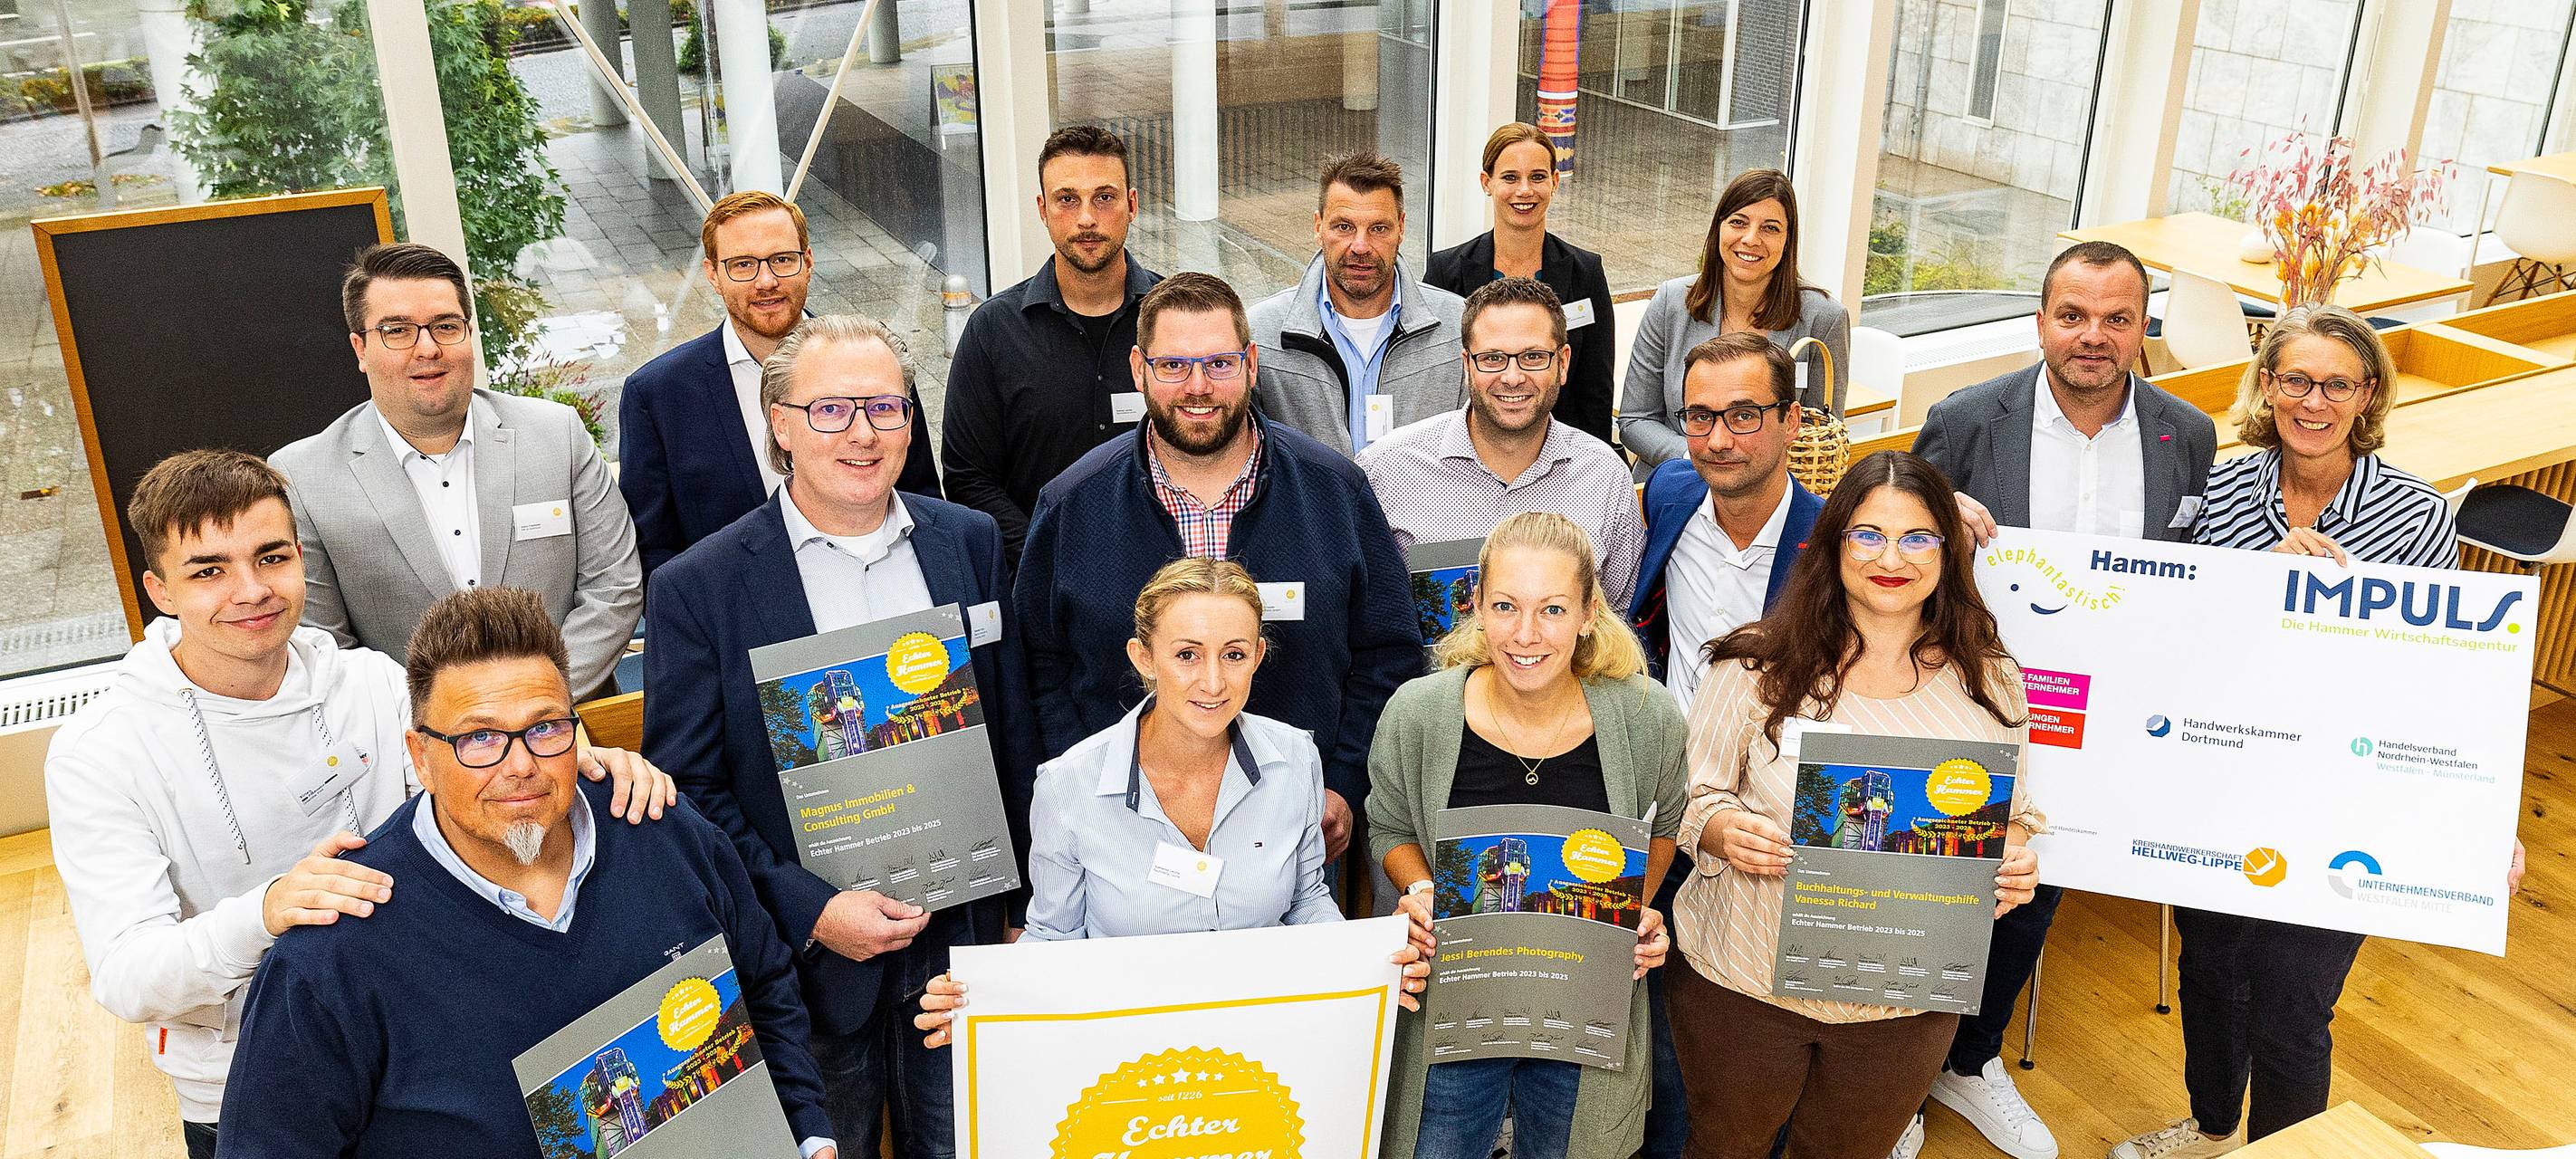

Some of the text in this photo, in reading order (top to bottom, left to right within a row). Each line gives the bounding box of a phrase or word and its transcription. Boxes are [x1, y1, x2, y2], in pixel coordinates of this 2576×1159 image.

[2091, 550, 2197, 580] Hamm:
[1987, 548, 2126, 610] elephantastisch!
[2281, 618, 2518, 652] Die Hammer Wirtschaftsagentur
[902, 651, 932, 664] Echter
[895, 658, 943, 677] Hammer
[2023, 682, 2080, 695] TERNEHMER
[2027, 674, 2071, 685] FAMILIEN
[2028, 713, 2060, 723] UNGEN
[2028, 722, 2074, 734] RNEHMER
[2183, 717, 2303, 742] Handwerkskammer
[2181, 732, 2244, 749] Dortmund
[2379, 740, 2457, 757] Handelsverband
[2378, 751, 2478, 770] Nordrhein-Westfalen
[2377, 762, 2425, 775] Westfalen
[2433, 769, 2496, 784] Münsterland
[800, 783, 916, 819] Magnus Immobilien &
[804, 803, 895, 832] Consulting GmbH
[810, 819, 942, 857] Echter Hammer Betrieb 2023 bis 2025
[2131, 846, 2243, 871] HELLWEG-LIPPE
[2132, 838, 2244, 861] KREISHANDWERKERSCHAFT
[1796, 881, 1980, 905] Buchhaltungs- und Verwaltungshilfe
[2359, 878, 2494, 906] UNTERNEHMENSVERBAND
[1795, 895, 1877, 910] Vanessa Richard
[2357, 892, 2453, 914] WESTFALEN MITTE
[1791, 918, 1926, 937] Echter Hammer Betrieb 2023 bis 2025
[664, 942, 685, 957] GANT
[1441, 945, 1585, 963] Jessi Berendes Photography
[1439, 970, 1569, 984] Echter Hammer Betrieb 2023 bis 2025
[1157, 1089, 1203, 1102] seit 1226
[1121, 1115, 1241, 1147] Echter
